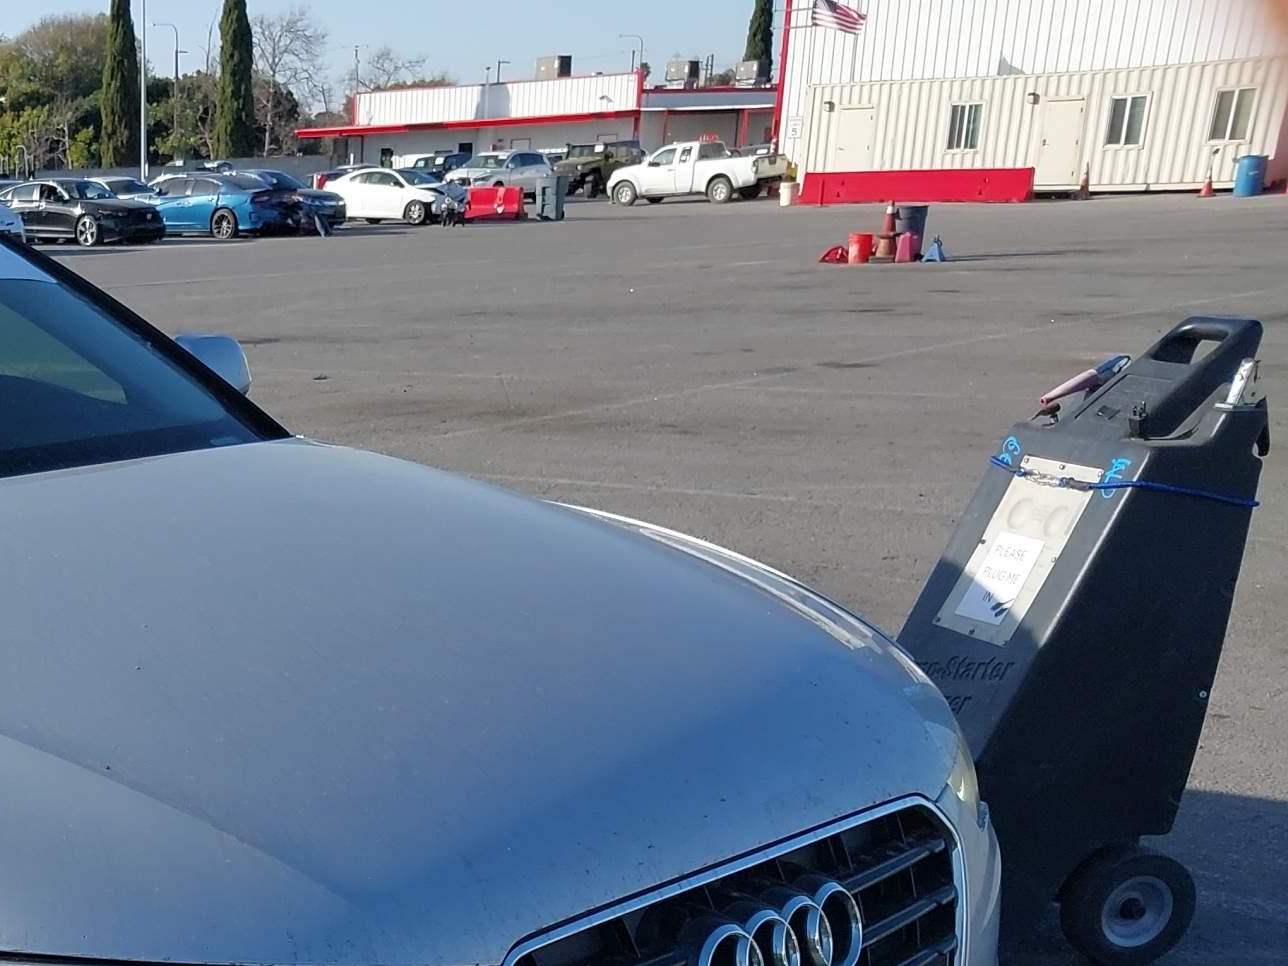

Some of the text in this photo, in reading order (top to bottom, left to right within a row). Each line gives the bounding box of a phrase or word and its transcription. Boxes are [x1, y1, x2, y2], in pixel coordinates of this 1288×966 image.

[995, 544, 1028, 562] PLEASE
[984, 566, 1022, 585] PLUG ME
[983, 591, 993, 602] IN
